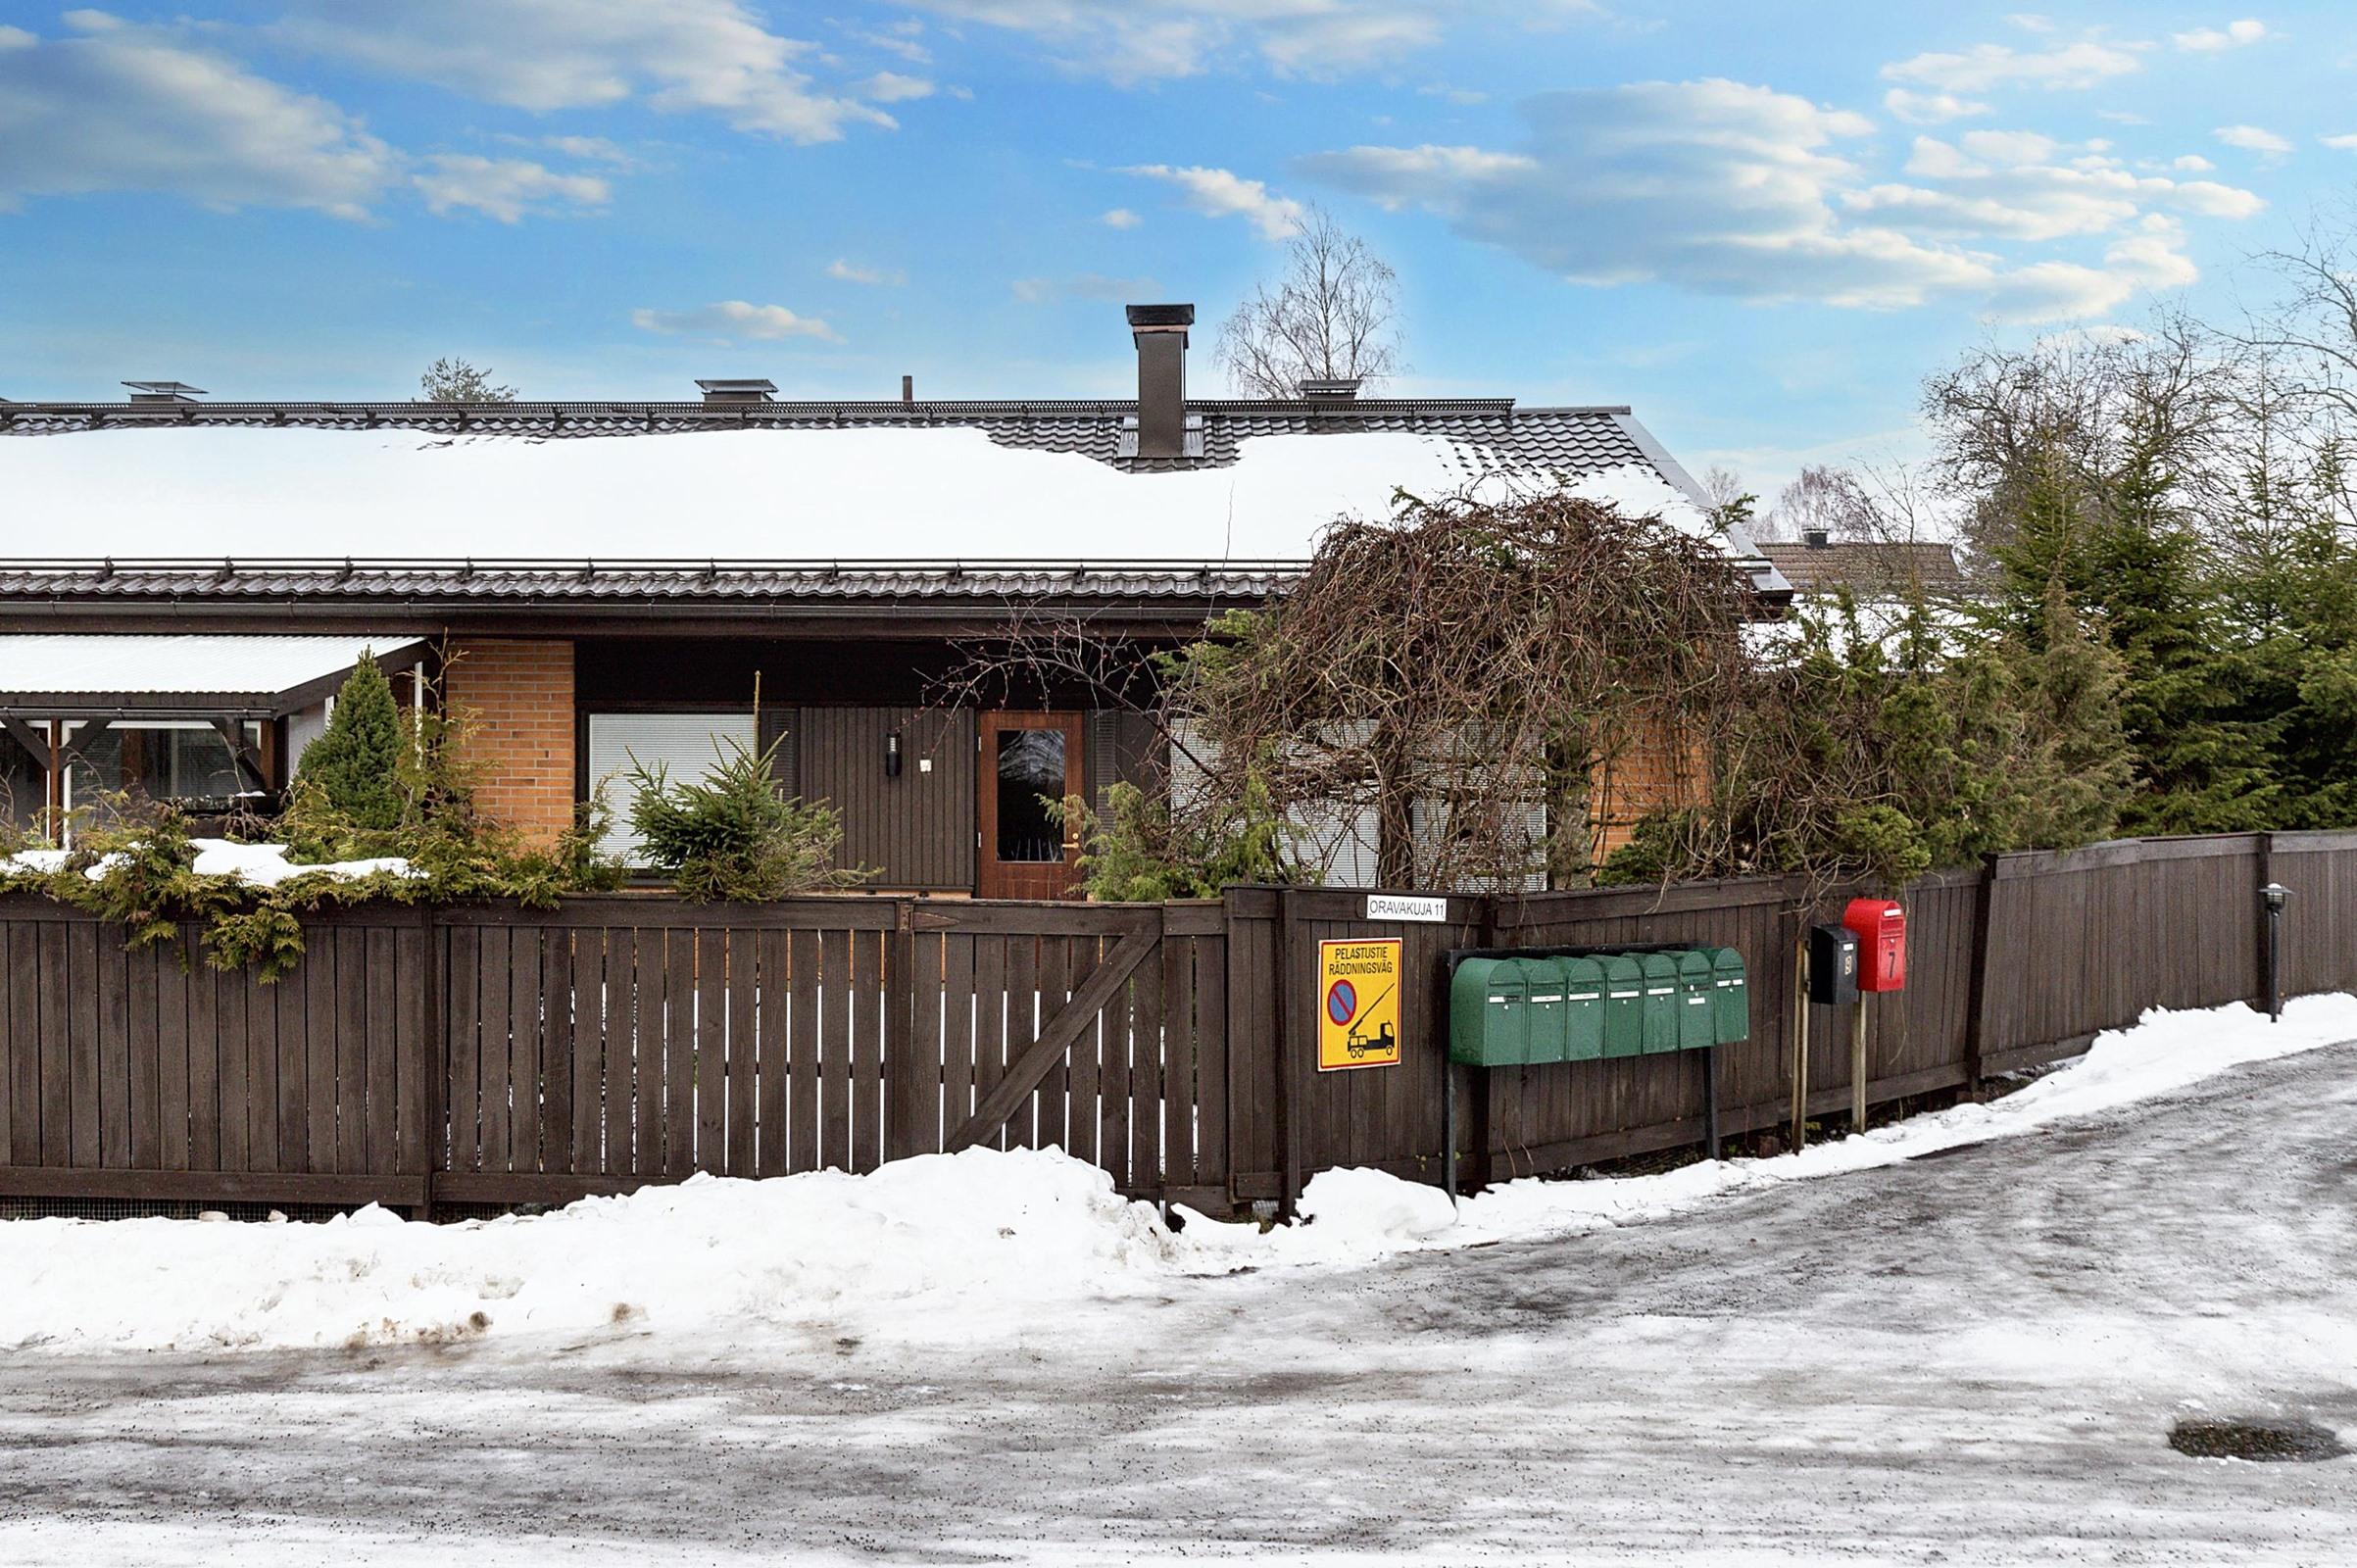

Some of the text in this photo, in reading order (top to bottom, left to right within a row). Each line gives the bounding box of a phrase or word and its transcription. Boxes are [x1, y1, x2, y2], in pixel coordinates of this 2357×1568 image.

[1369, 900, 1444, 916] ORAVAKUJA 11
[1335, 947, 1388, 959] PELASTUSTIE
[1329, 959, 1393, 975] RÄDDNINGSVÄG
[1889, 951, 1895, 979] 7
